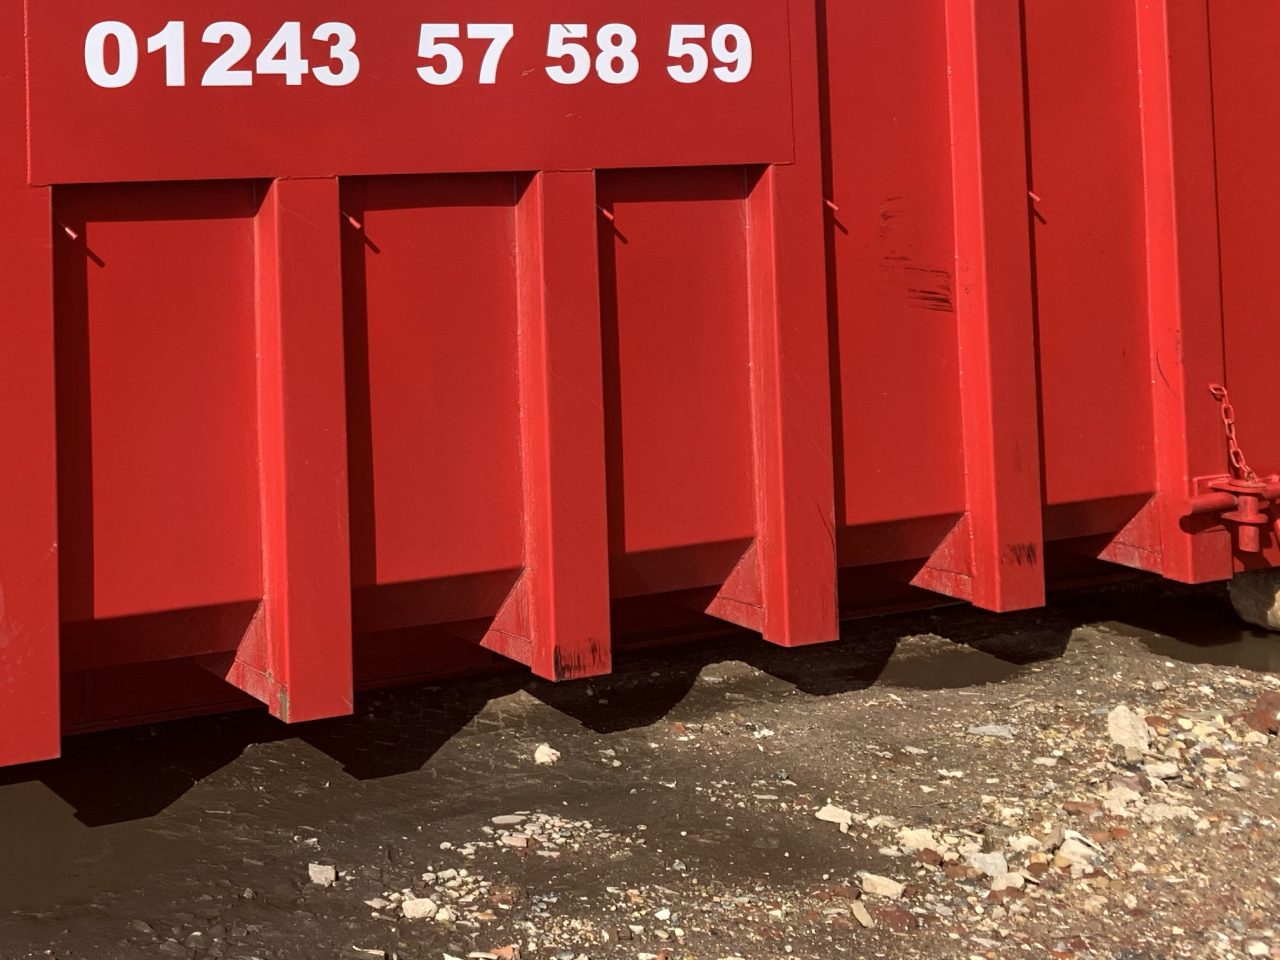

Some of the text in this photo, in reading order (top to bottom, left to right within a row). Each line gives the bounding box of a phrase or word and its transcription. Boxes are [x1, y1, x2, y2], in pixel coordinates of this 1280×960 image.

[84, 20, 753, 89] 01243 57 58 59
